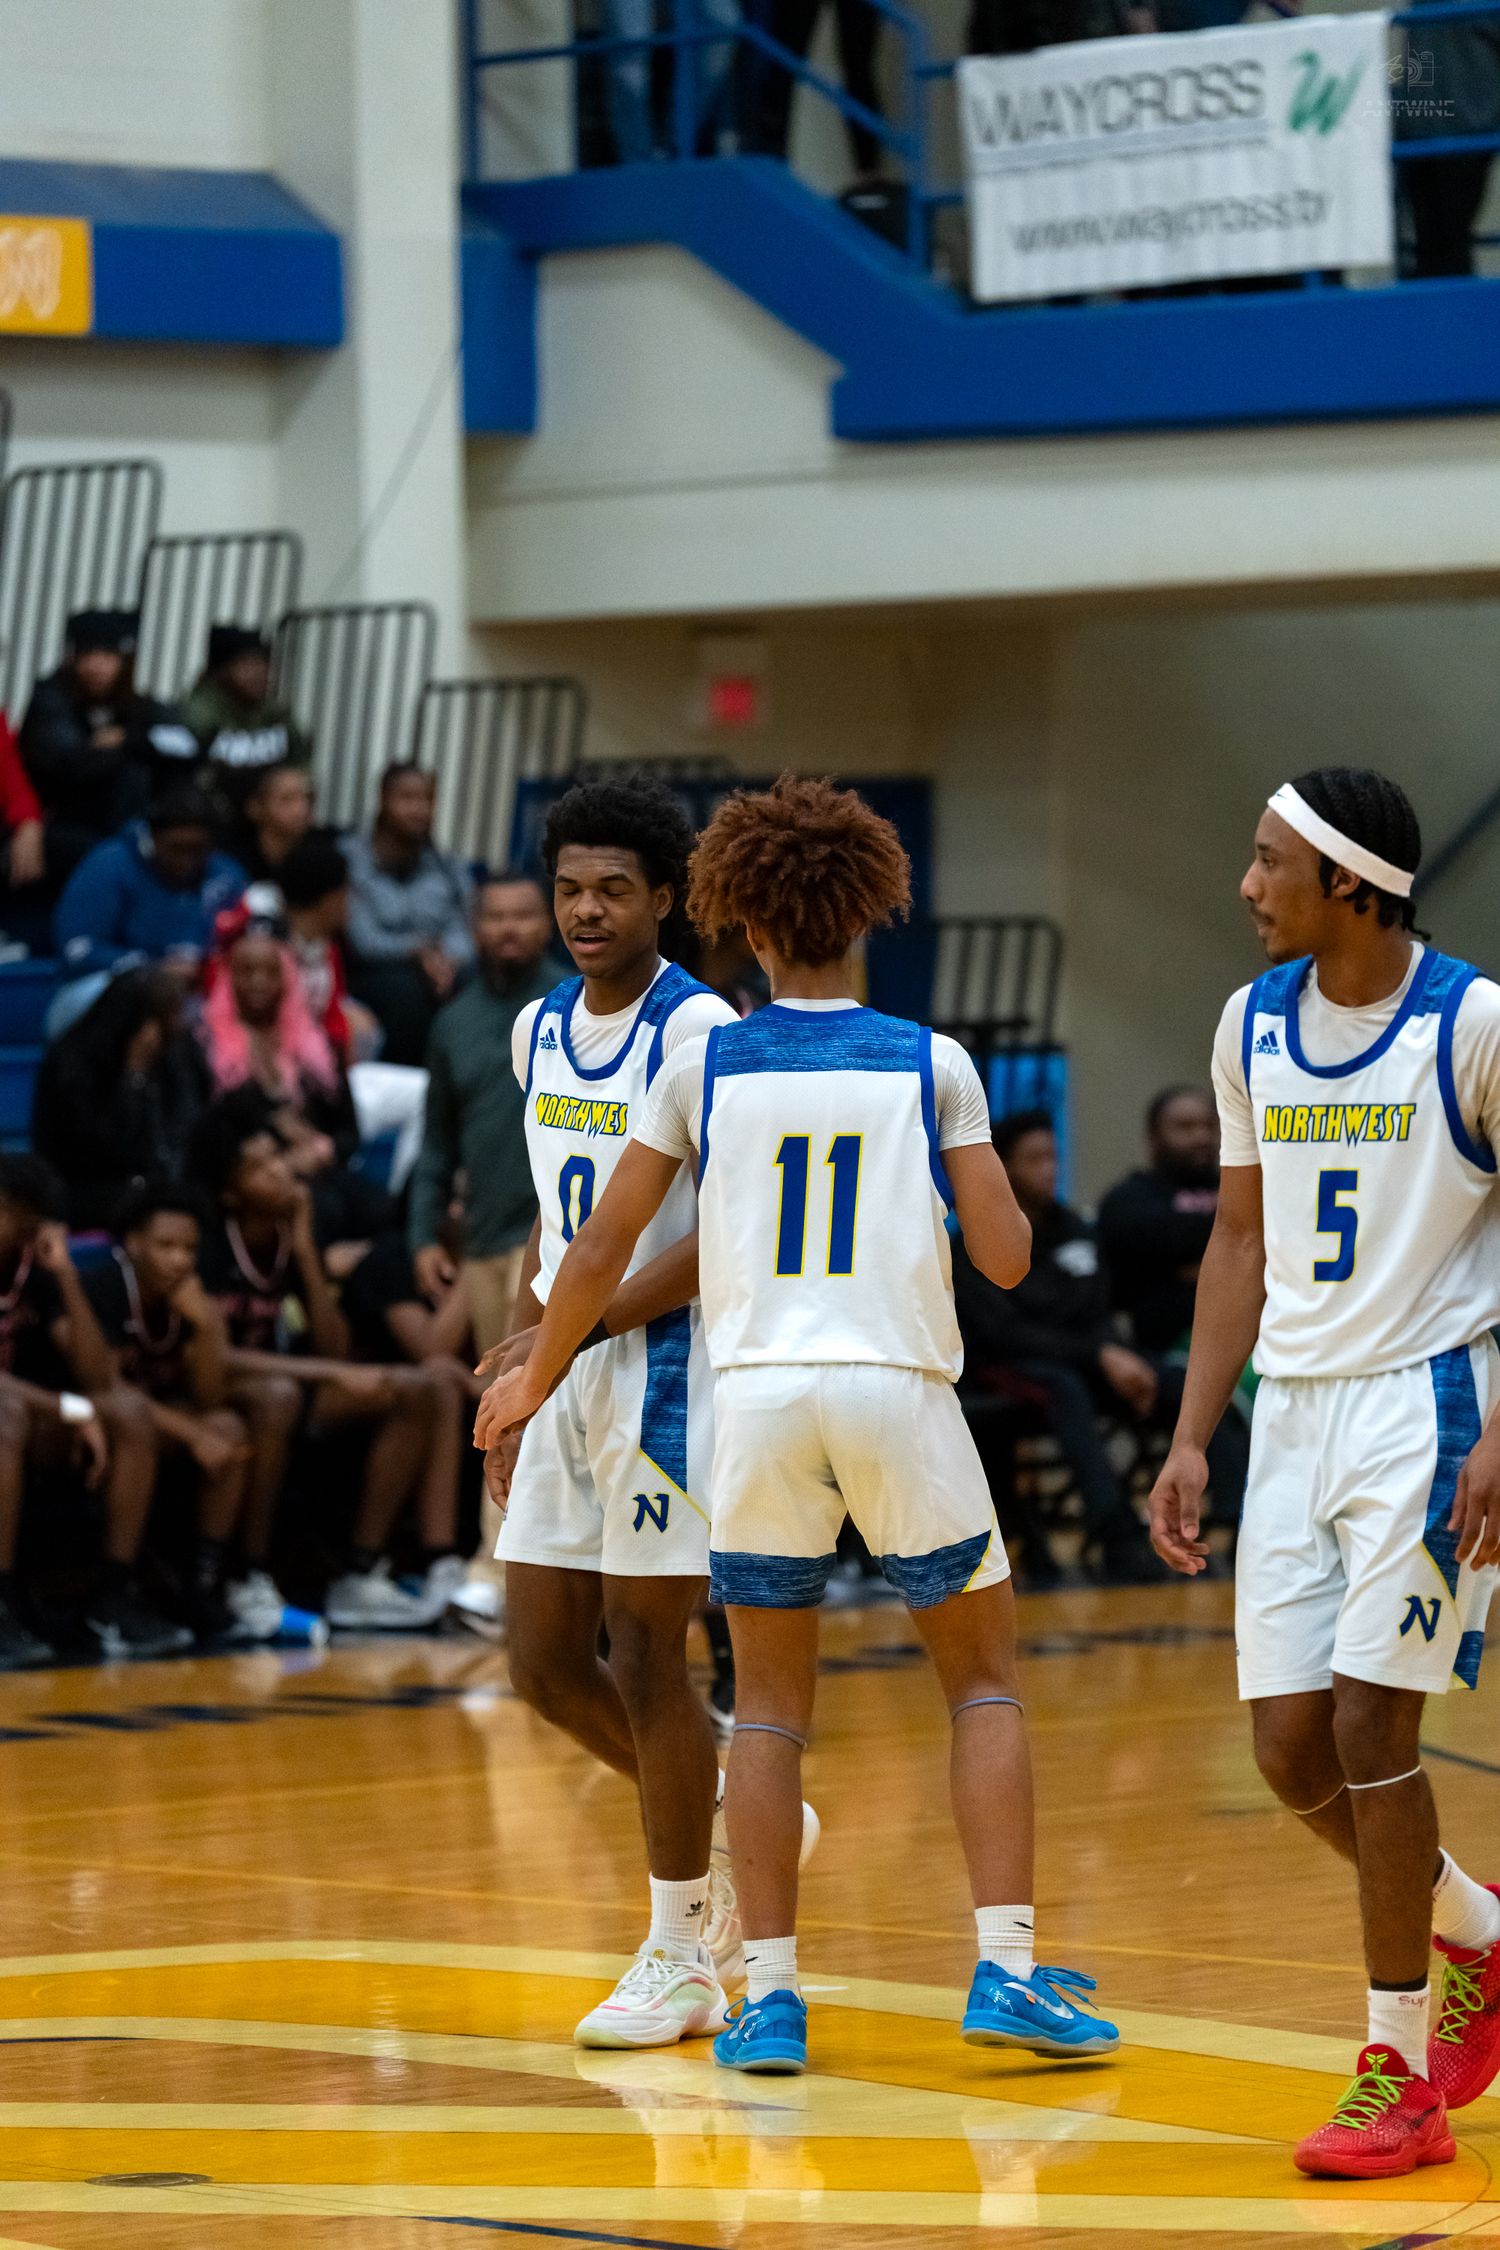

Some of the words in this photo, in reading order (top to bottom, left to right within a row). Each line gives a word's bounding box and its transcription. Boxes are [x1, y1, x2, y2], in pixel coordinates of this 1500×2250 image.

[967, 58, 1265, 146] WAYCROSS
[535, 1092, 629, 1139] NORTHWES
[1262, 1103, 1417, 1149] NORTHWEST
[558, 1153, 596, 1245] 0
[772, 1132, 865, 1278] 11
[1312, 1168, 1360, 1285] 5
[632, 1493, 670, 1534] N
[1398, 1594, 1442, 1643] N
